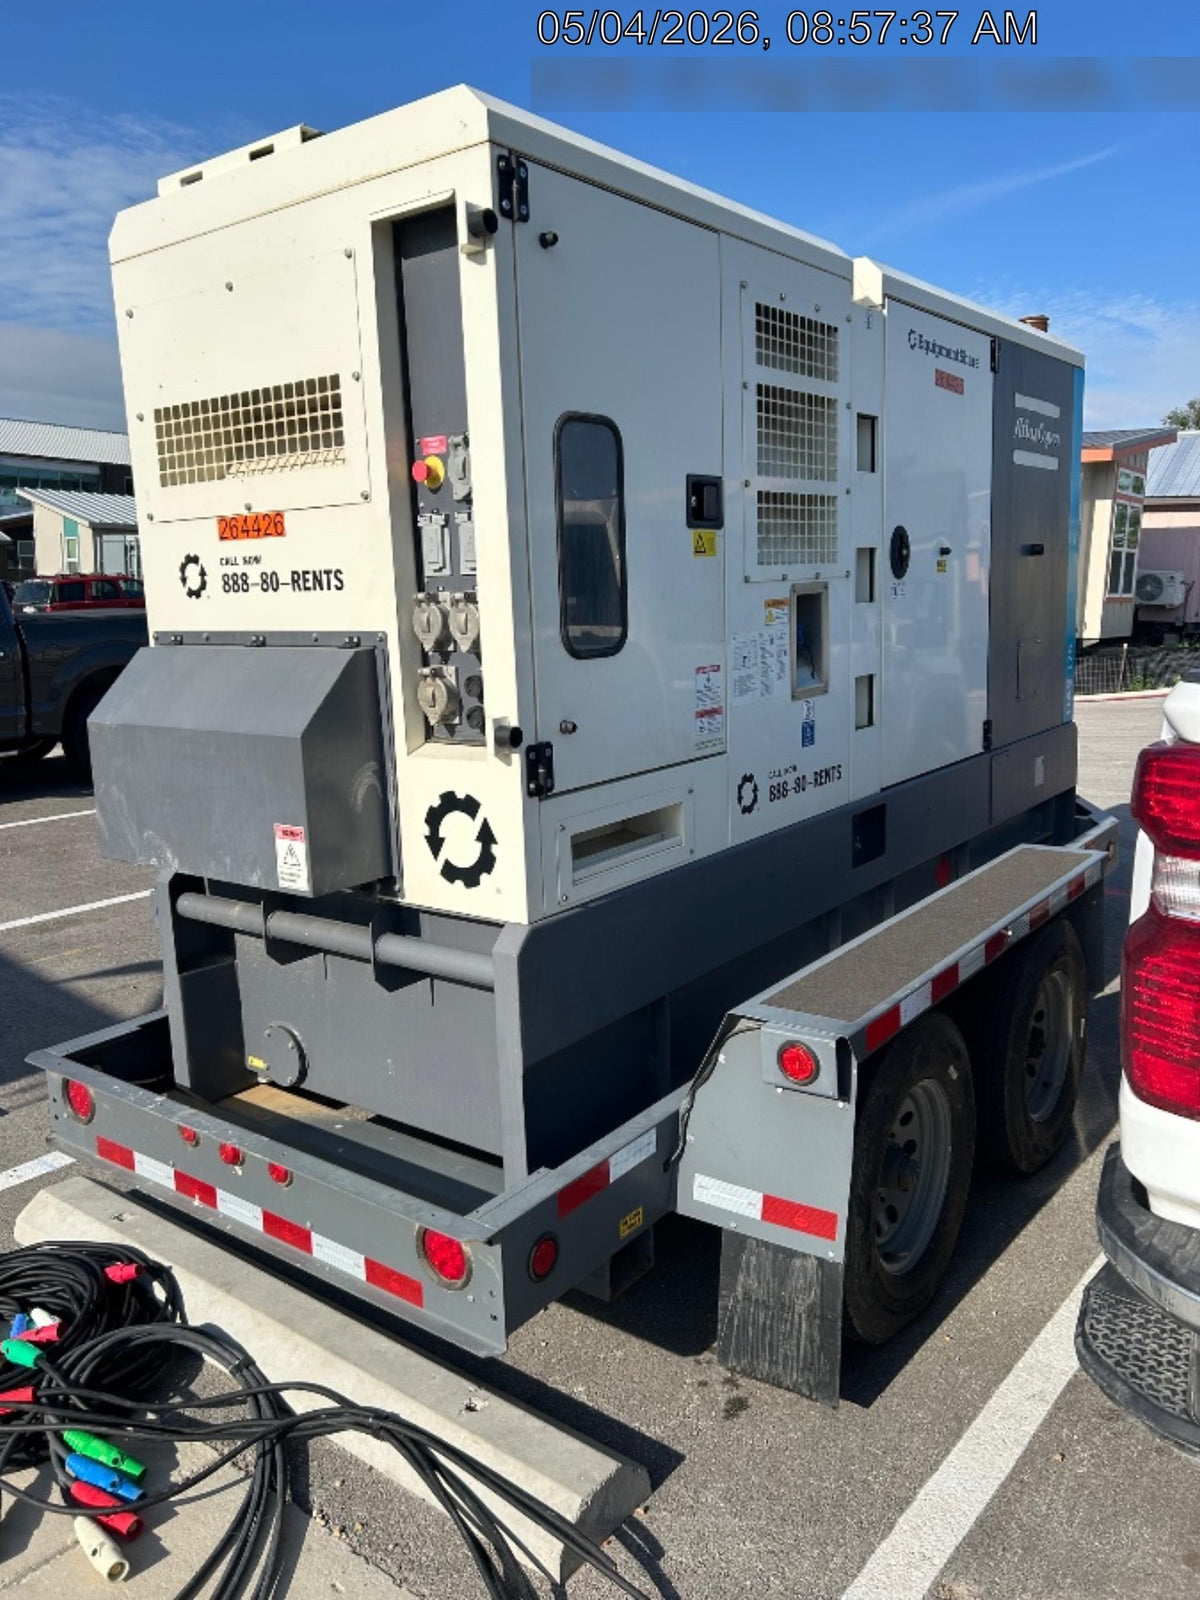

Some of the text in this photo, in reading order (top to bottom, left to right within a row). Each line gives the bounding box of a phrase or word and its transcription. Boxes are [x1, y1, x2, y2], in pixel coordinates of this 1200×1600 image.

[219, 512, 285, 540] 264426
[219, 556, 239, 566] CALL
[221, 568, 345, 593] 888-80-RENTS
[769, 764, 842, 802] 888-80-RENTS
